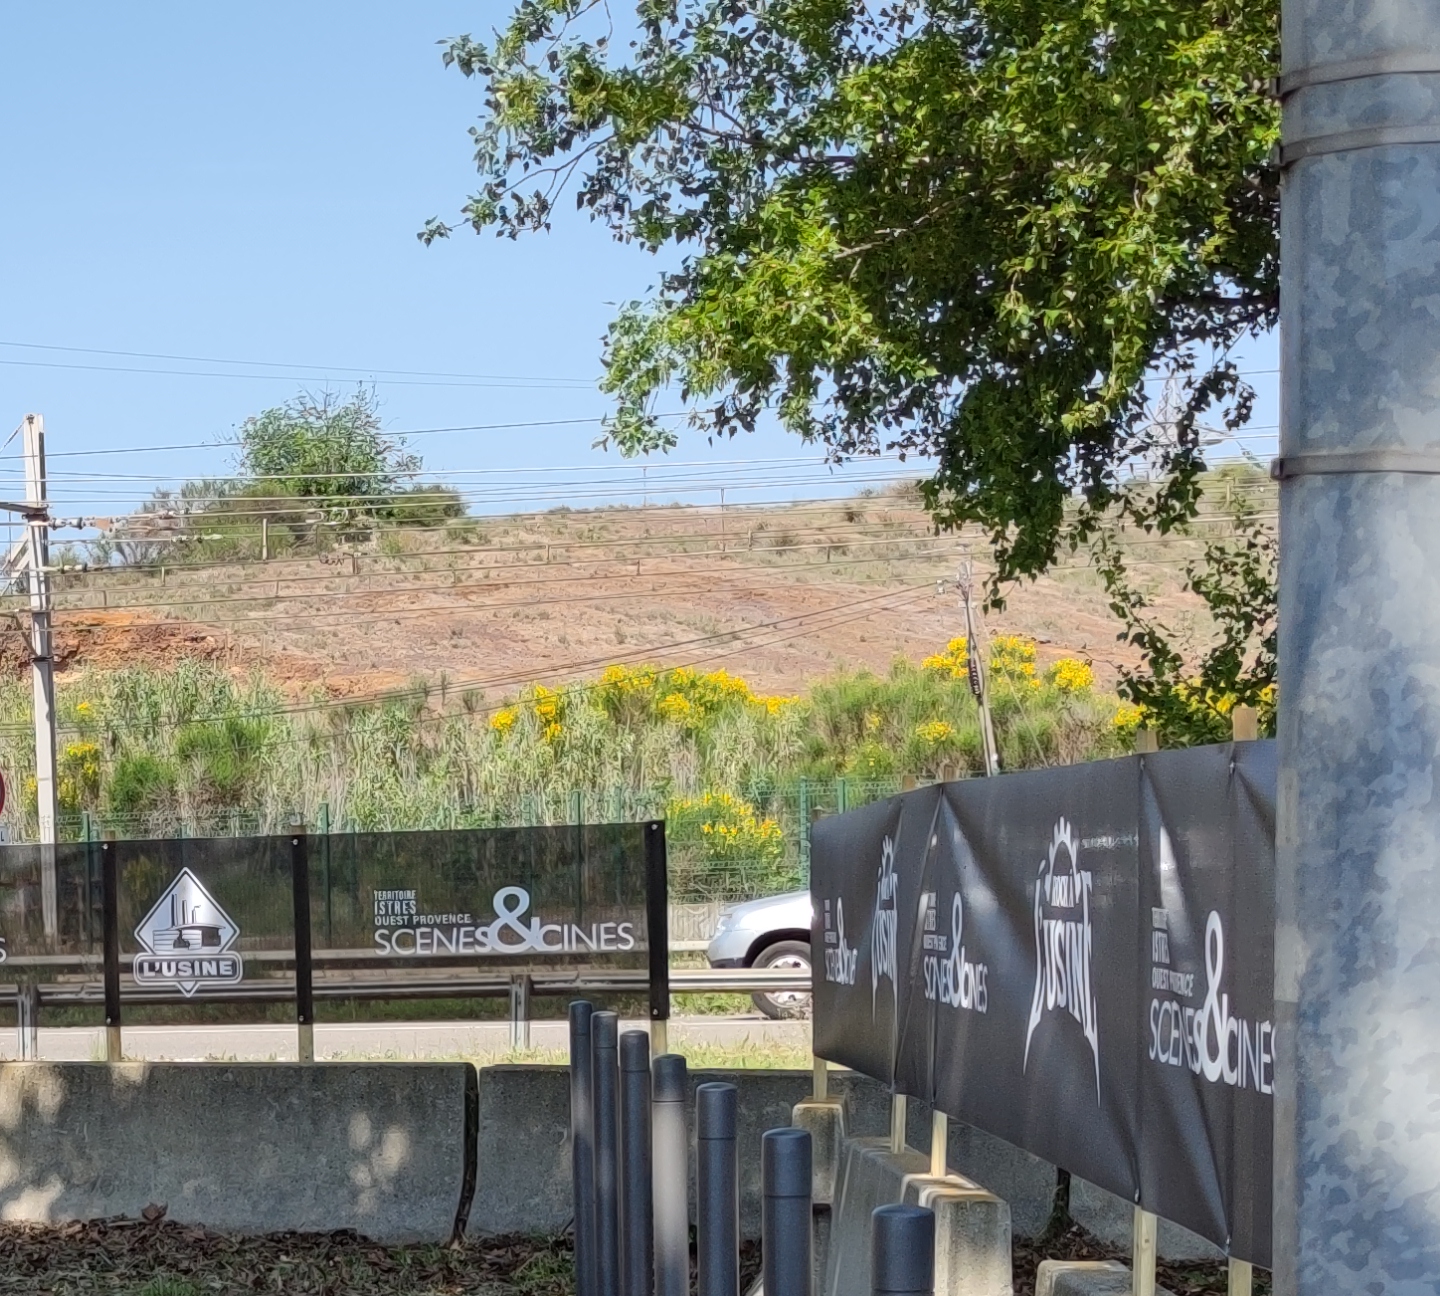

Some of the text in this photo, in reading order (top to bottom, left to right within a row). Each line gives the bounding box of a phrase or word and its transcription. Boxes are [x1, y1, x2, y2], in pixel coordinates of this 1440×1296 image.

[374, 889, 416, 900] TERRITOIRE
[374, 900, 416, 915] ISTRES
[374, 913, 472, 926] OUEST PROVENCE
[142, 960, 233, 977] L'USINE
[1022, 859, 1100, 1107] L'USINE
